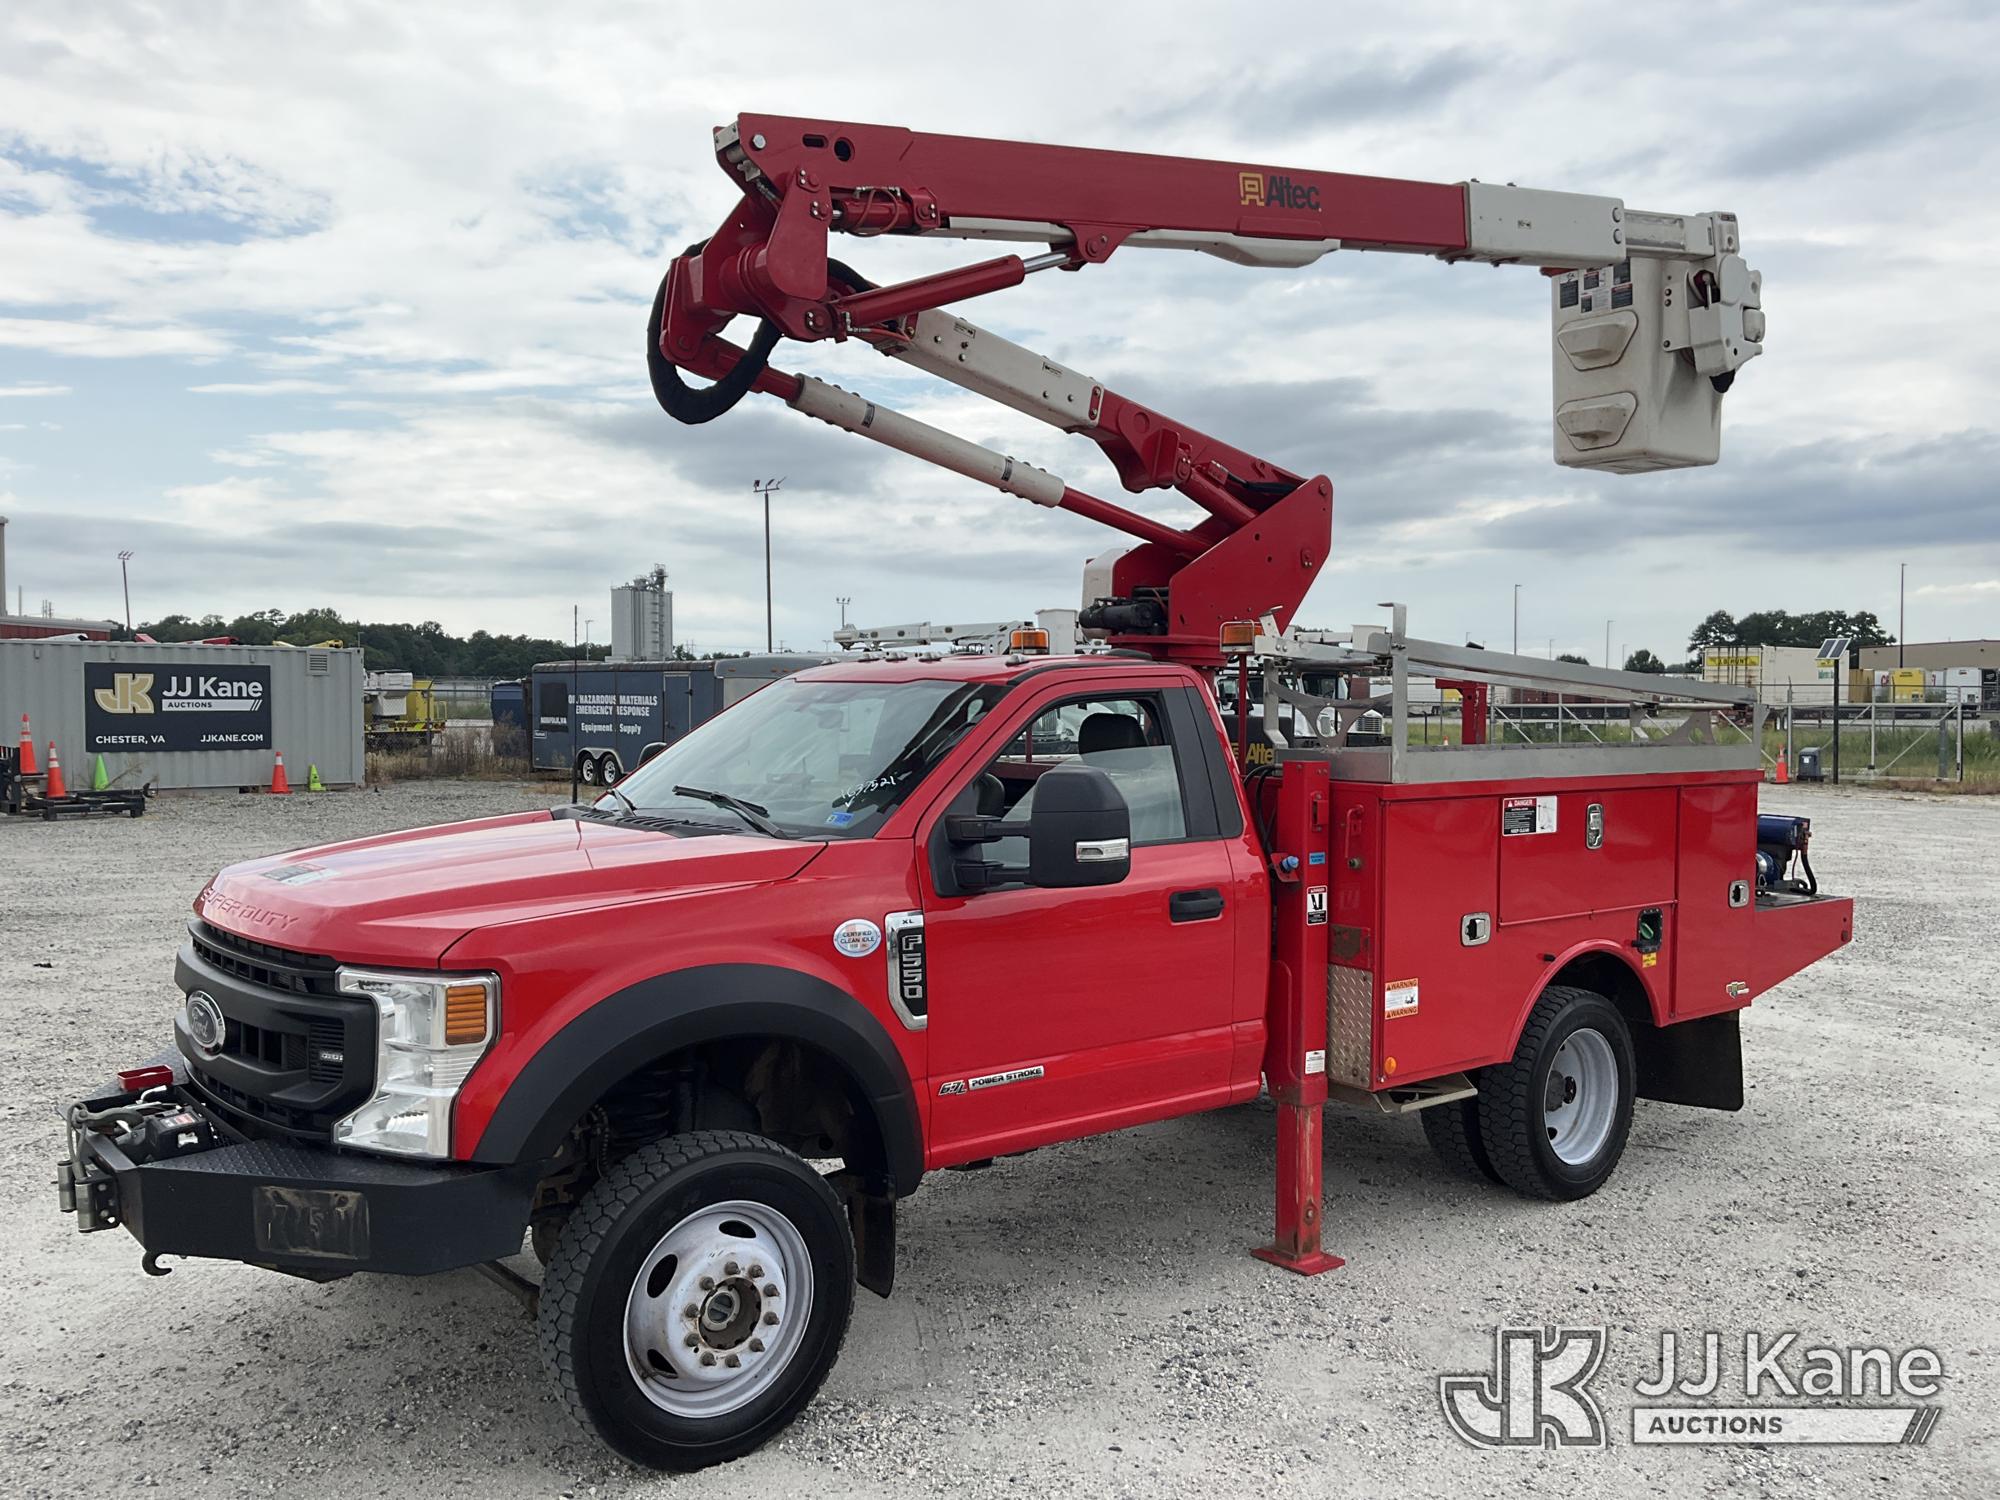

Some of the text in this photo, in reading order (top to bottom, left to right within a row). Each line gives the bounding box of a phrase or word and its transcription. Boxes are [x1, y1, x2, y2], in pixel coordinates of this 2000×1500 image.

[1265, 175, 1319, 209] Altec
[162, 676, 263, 698] JJ Kane
[167, 701, 213, 709] AUCTIONS
[619, 695, 658, 706] MATERIALS
[575, 705, 613, 716] EMERGENCY
[581, 722, 642, 735] Equipment Supply
[95, 735, 166, 745] CHESTER, VA
[200, 733, 264, 743] JJKANE.COM
[1246, 742, 1275, 765] Alte
[239, 904, 299, 929] DUTY
[1391, 979, 1417, 990] WARNING
[1391, 1006, 1417, 1017] WARNING
[971, 1075, 1004, 1087] POWER
[1006, 1067, 1042, 1080] STROKE
